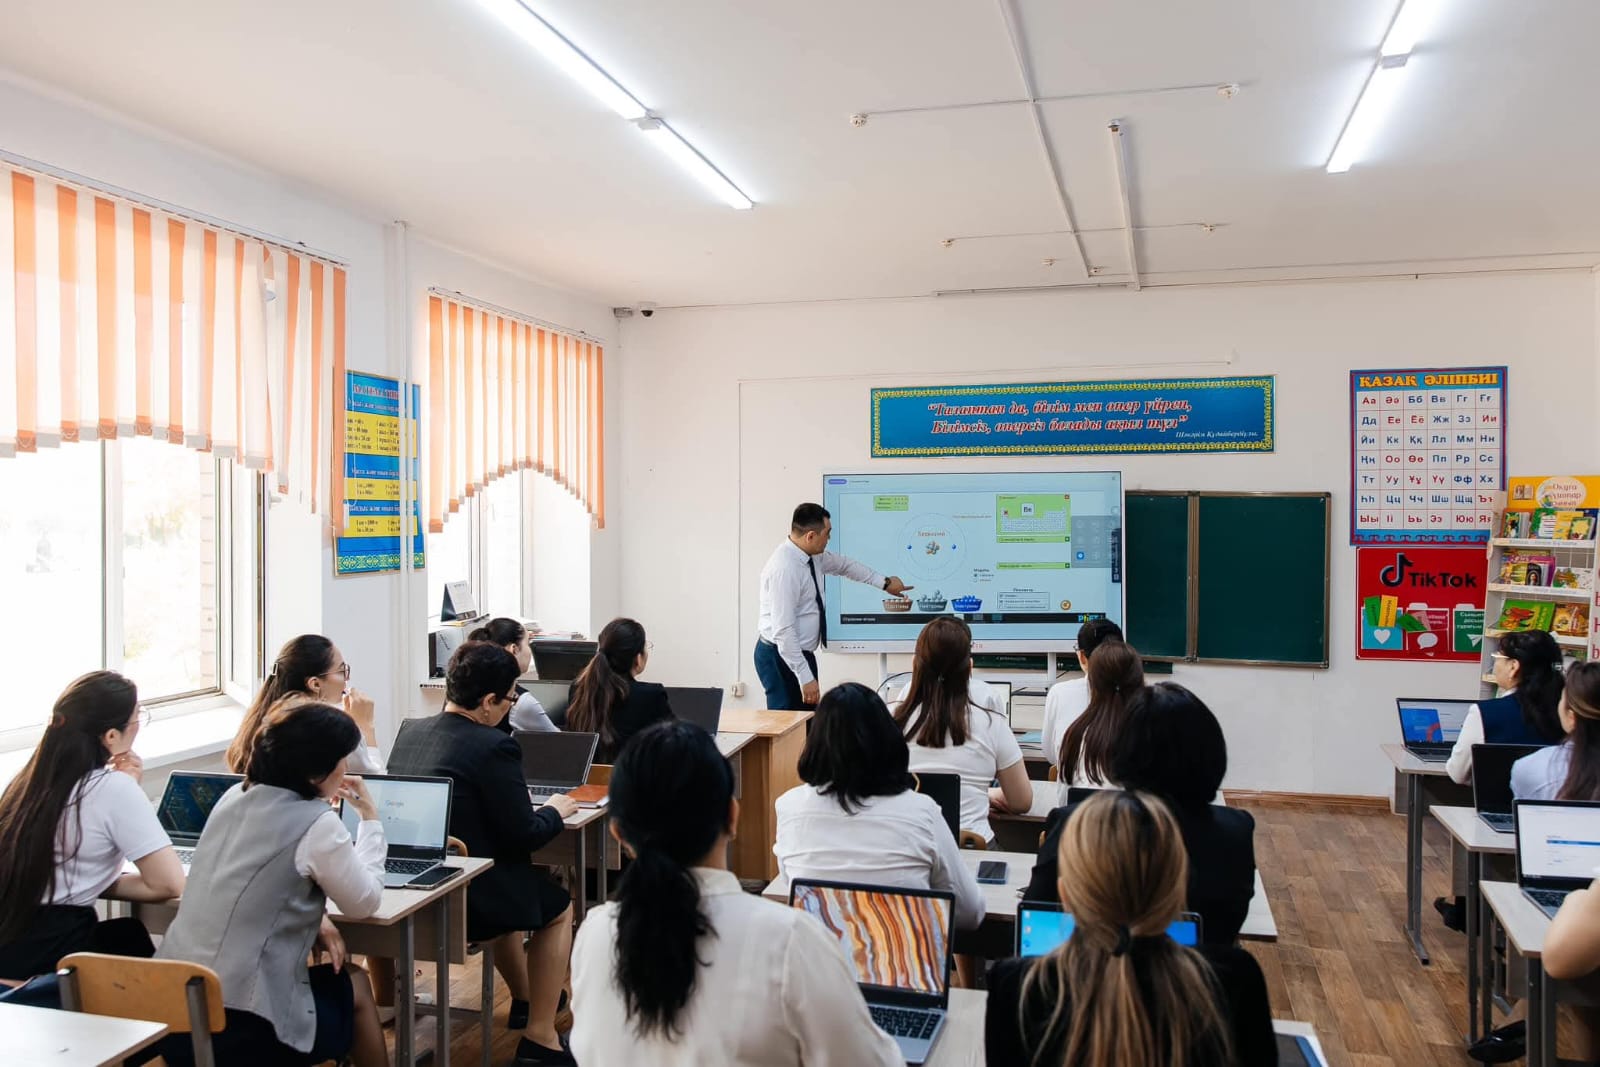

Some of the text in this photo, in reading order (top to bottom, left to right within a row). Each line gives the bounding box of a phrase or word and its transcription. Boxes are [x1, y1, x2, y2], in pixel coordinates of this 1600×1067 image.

[1360, 374, 1498, 388] ҚАЗАҚ ӘЛІПБИІ
[1362, 396, 1376, 404] Аа
[1408, 395, 1423, 404] Бб
[1431, 395, 1446, 403] Вв
[1456, 394, 1468, 403] Гг
[1009, 401, 1029, 416] да,
[1073, 402, 1102, 412] мен
[1361, 416, 1377, 426] Дд
[1388, 416, 1401, 425] Ее
[1433, 415, 1450, 424] Жж
[1458, 414, 1471, 423] Зз
[1482, 414, 1497, 423] Ии
[1386, 436, 1399, 444] Кк
[1431, 435, 1447, 443] Лл
[1456, 435, 1474, 443] Мм
[1480, 434, 1495, 442] Нн
[1385, 455, 1400, 463] Оо
[1456, 454, 1470, 464] Рр
[1479, 454, 1494, 462] Сс
[1362, 476, 1375, 484] Тт
[1386, 475, 1399, 484] Уу
[1453, 475, 1473, 484] Фф
[1480, 475, 1494, 483] Хх
[1386, 495, 1400, 505] Цц
[1409, 495, 1423, 503] Чч
[1455, 495, 1473, 504] Щщ
[1360, 514, 1379, 522] Ыы
[1408, 514, 1422, 522] Ьь
[1456, 514, 1474, 522] Юю
[1409, 572, 1477, 588] TikTok
